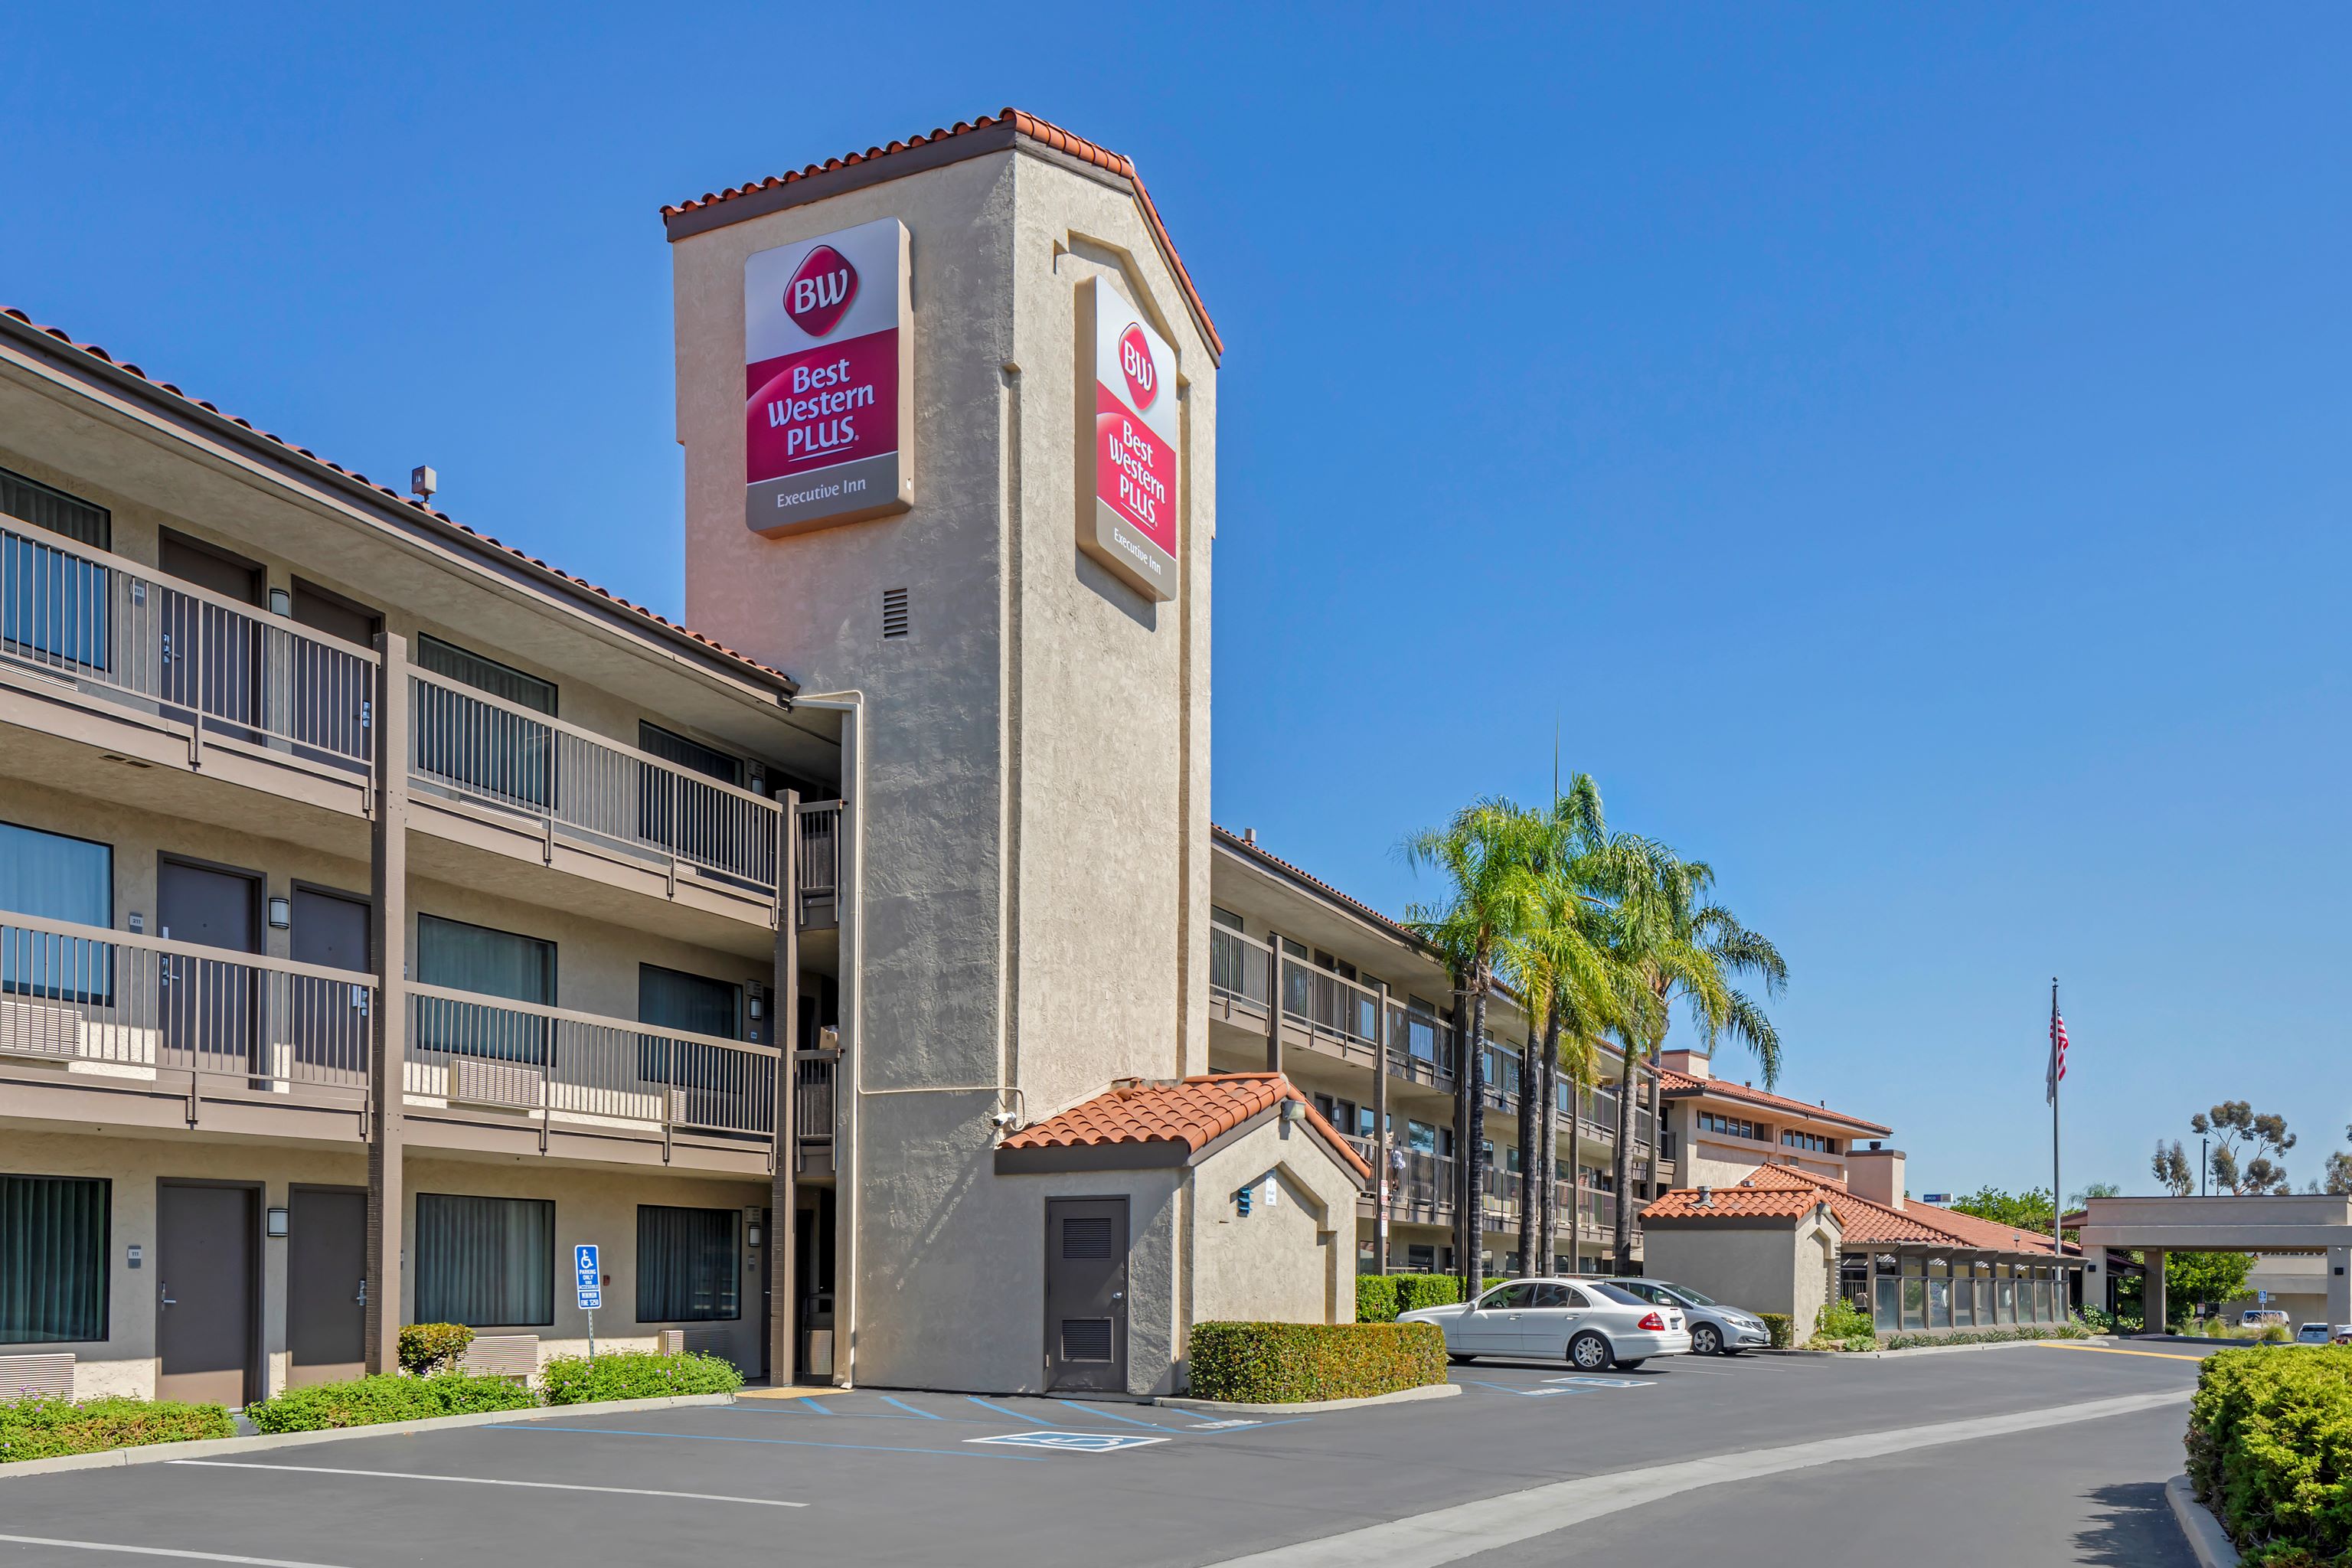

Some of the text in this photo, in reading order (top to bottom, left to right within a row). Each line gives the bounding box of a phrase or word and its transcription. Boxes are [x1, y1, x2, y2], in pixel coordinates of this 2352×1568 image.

[794, 268, 848, 315] BW
[793, 358, 851, 394] Best
[1123, 340, 1152, 391] BW
[768, 384, 875, 428] Western
[1122, 420, 1154, 469] Best
[776, 476, 866, 508] Executive Inn
[1109, 433, 1165, 505] Western
[1114, 527, 1161, 575] Executive Inn
